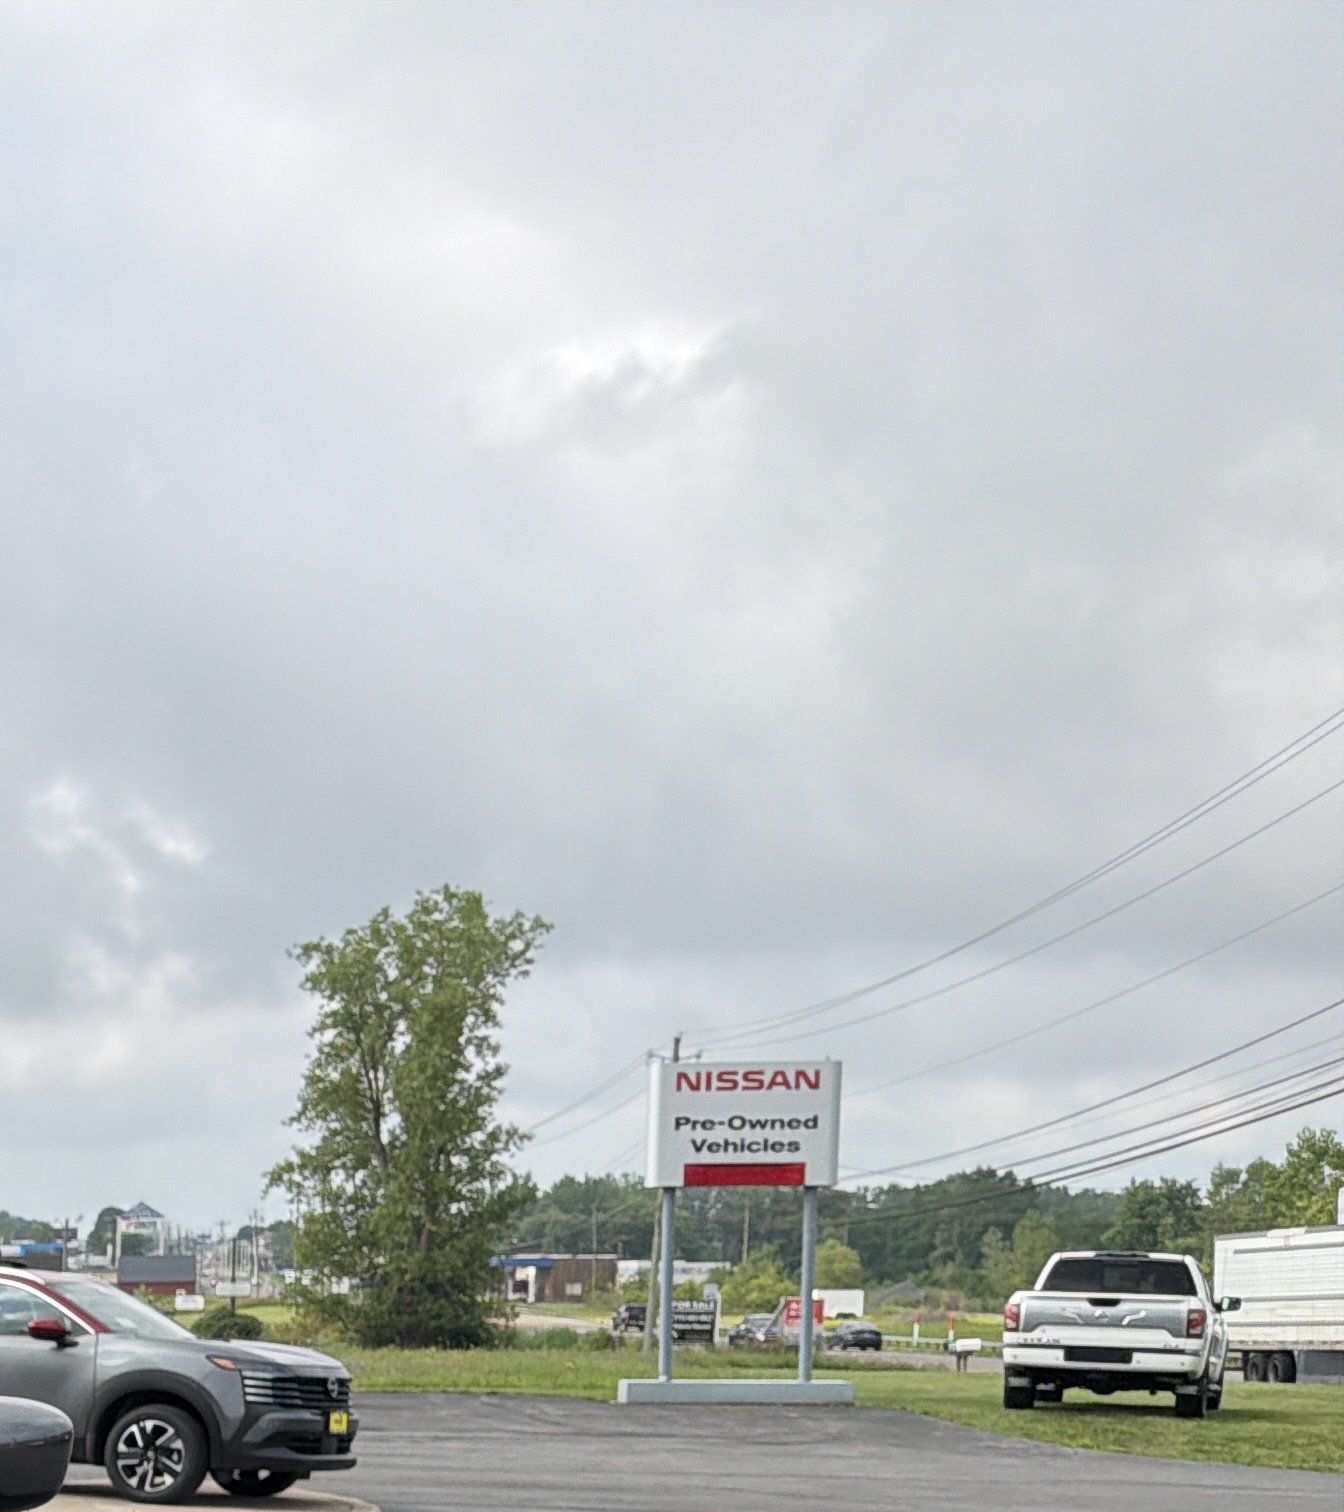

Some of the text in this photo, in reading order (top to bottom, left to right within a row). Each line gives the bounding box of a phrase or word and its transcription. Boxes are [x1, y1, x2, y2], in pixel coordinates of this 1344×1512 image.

[676, 1069, 821, 1092] NISSAN
[674, 1115, 819, 1131] Pre-Owned
[690, 1137, 801, 1153] Vehicles
